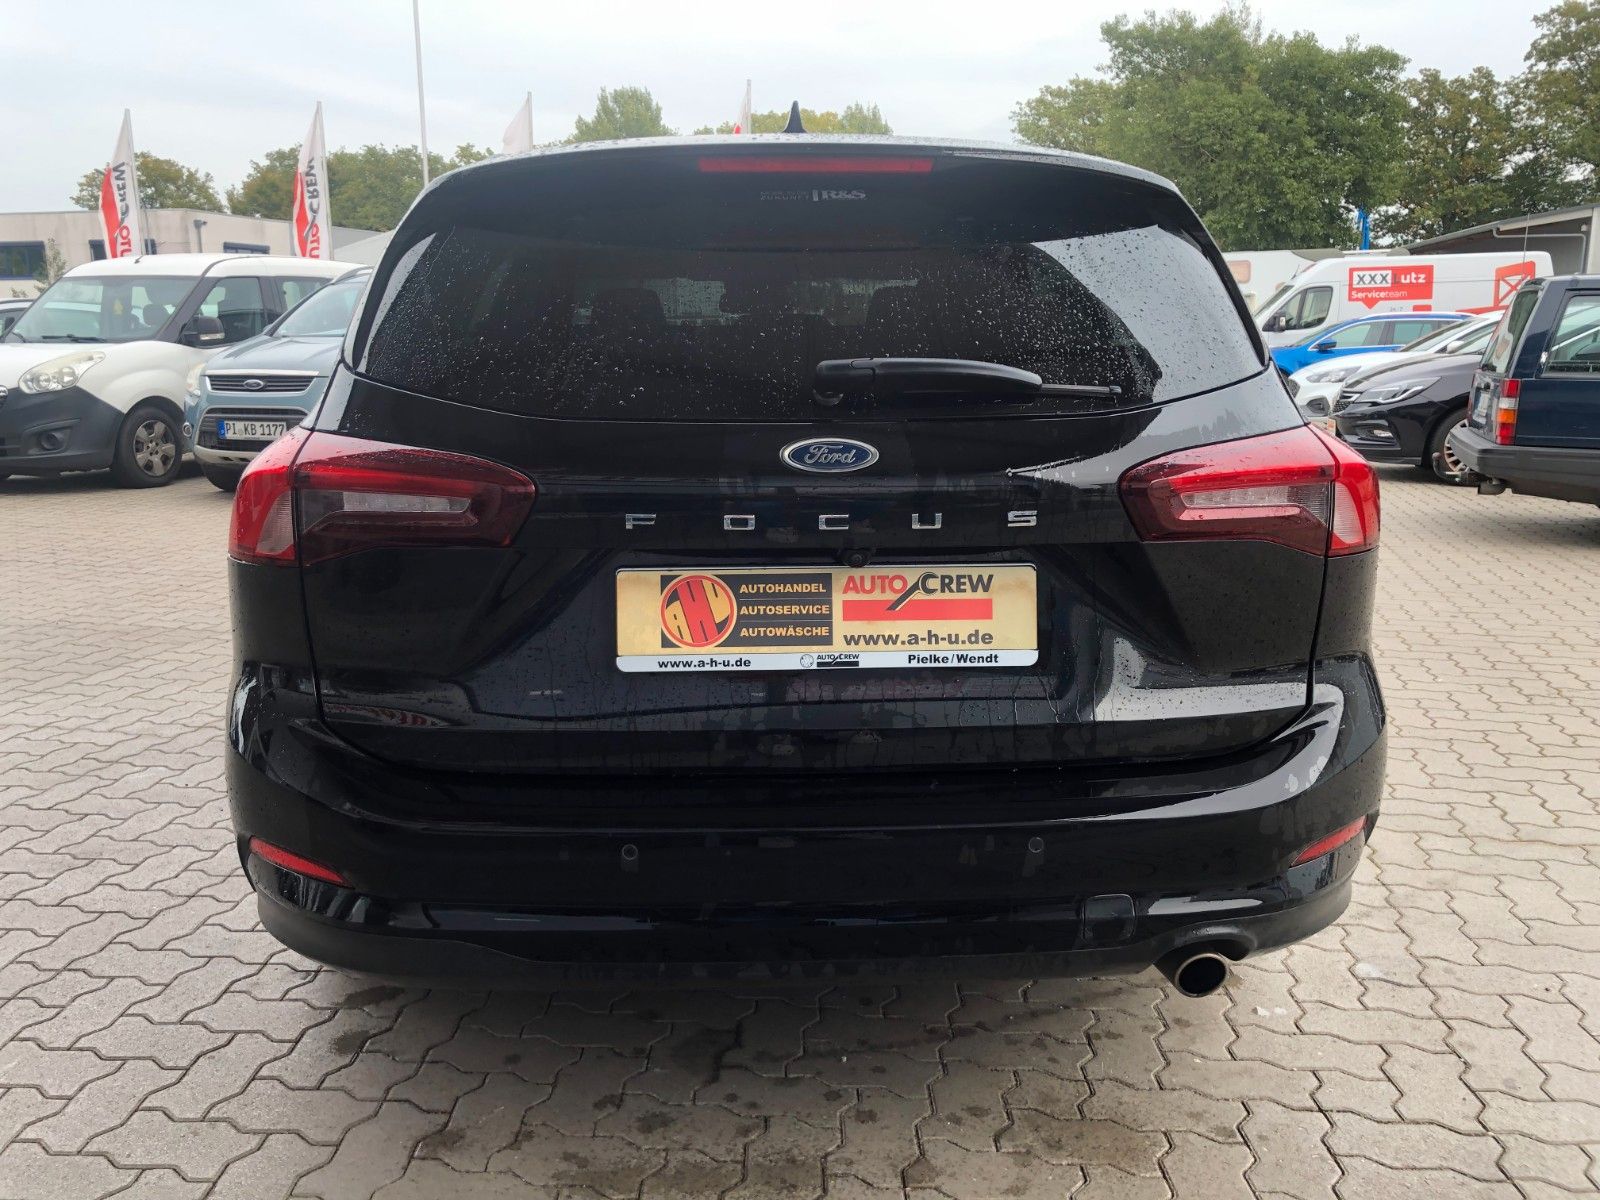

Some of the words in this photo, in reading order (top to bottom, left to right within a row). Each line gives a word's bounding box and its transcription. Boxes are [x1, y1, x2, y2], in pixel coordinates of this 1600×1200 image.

[1351, 290, 1408, 299] Serviceteam
[226, 422, 237, 435] PI
[244, 423, 257, 436] KB
[260, 423, 285, 436] 1177
[804, 444, 856, 464] Ford
[625, 510, 1038, 531] FOCUS
[739, 583, 827, 595] AUTOHANDEL
[842, 574, 908, 595] AUTO
[918, 572, 994, 595] CREW
[739, 603, 831, 616] AUTOSERVICE
[739, 624, 830, 638] AUTOWÄSCHE
[843, 629, 994, 647] www.a-h-u.de
[657, 656, 752, 669] www.a-h-u.de
